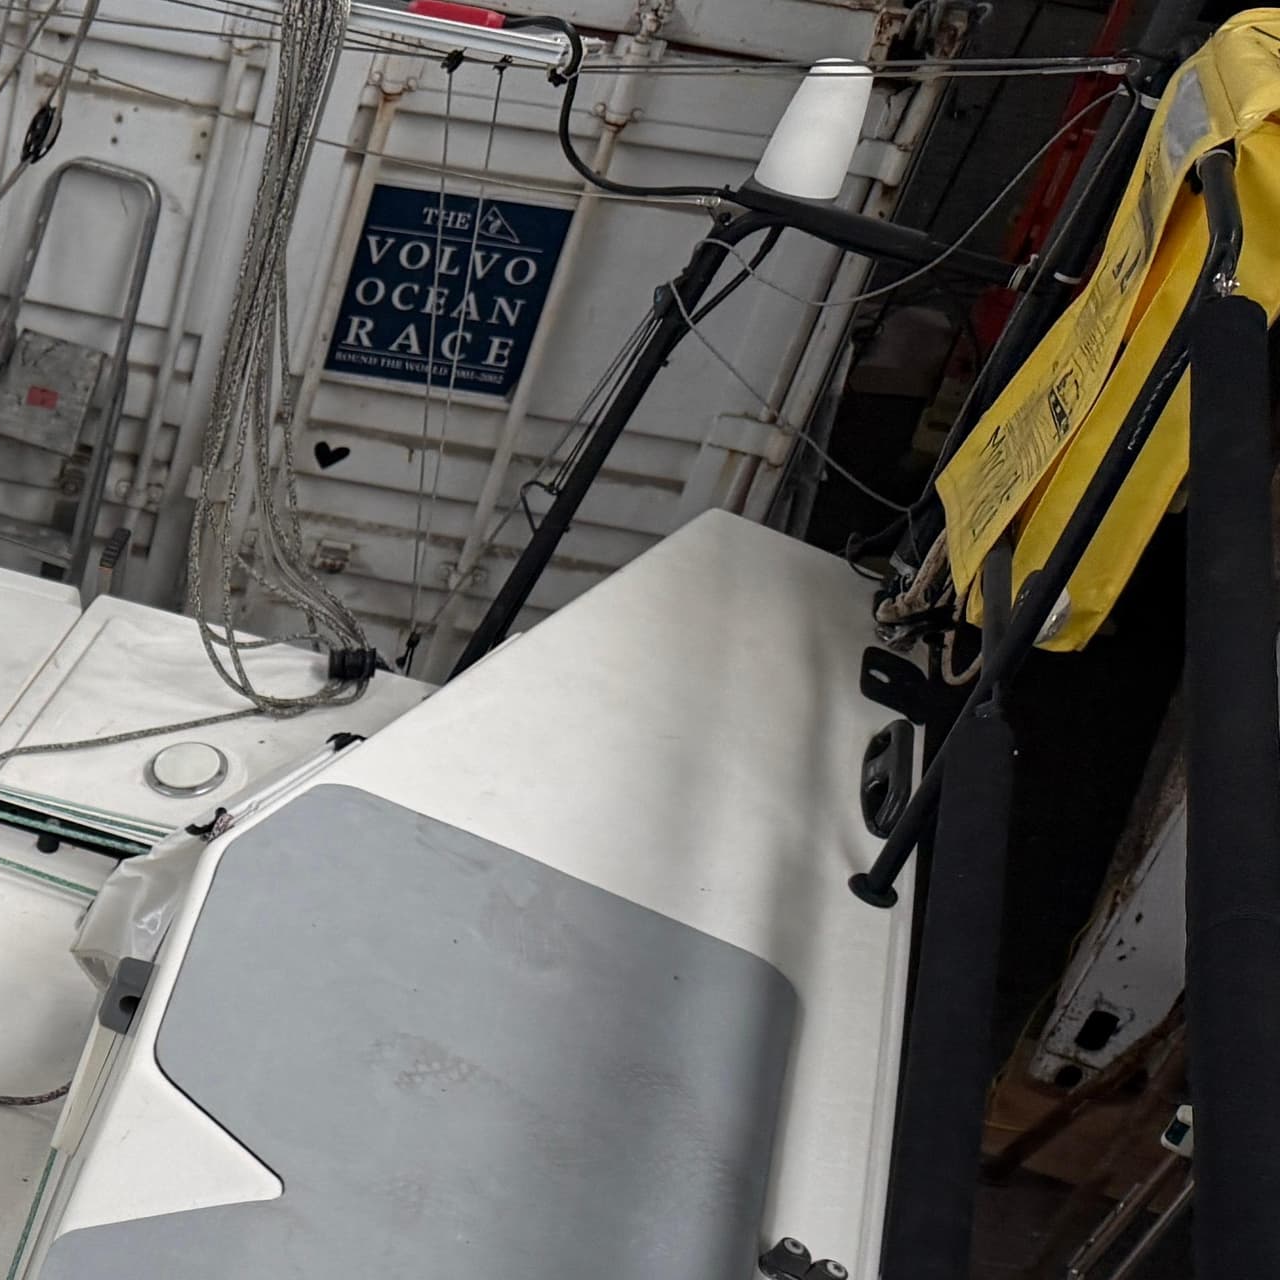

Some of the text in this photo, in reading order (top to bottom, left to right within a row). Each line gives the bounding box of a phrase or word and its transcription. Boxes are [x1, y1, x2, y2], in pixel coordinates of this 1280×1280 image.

[422, 206, 472, 231] THE
[366, 234, 538, 286] VOLVO
[355, 277, 527, 328] OCEAN
[341, 315, 515, 369] RACE
